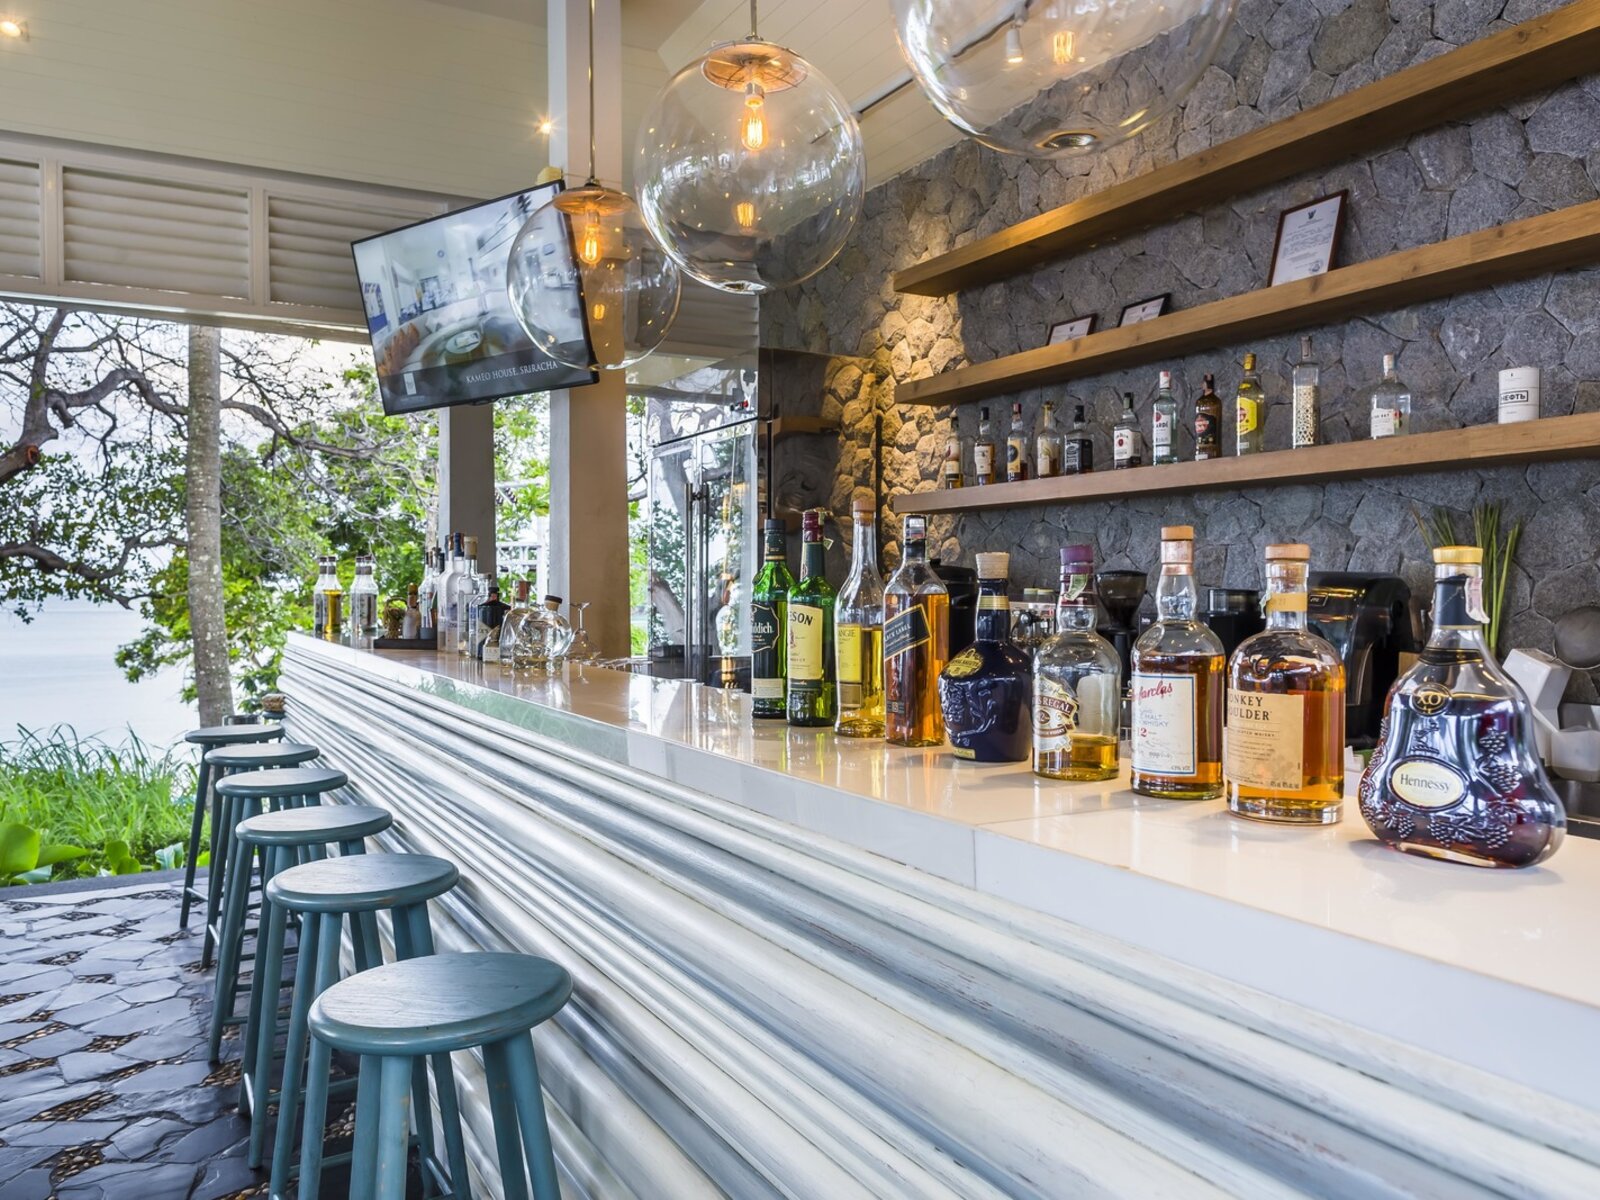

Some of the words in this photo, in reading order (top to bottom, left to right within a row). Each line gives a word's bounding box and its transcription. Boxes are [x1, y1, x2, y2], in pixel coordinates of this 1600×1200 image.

[519, 360, 558, 375] SRIRACHA
[1042, 696, 1071, 714] REGAL
[1400, 773, 1451, 793] Hennessy
